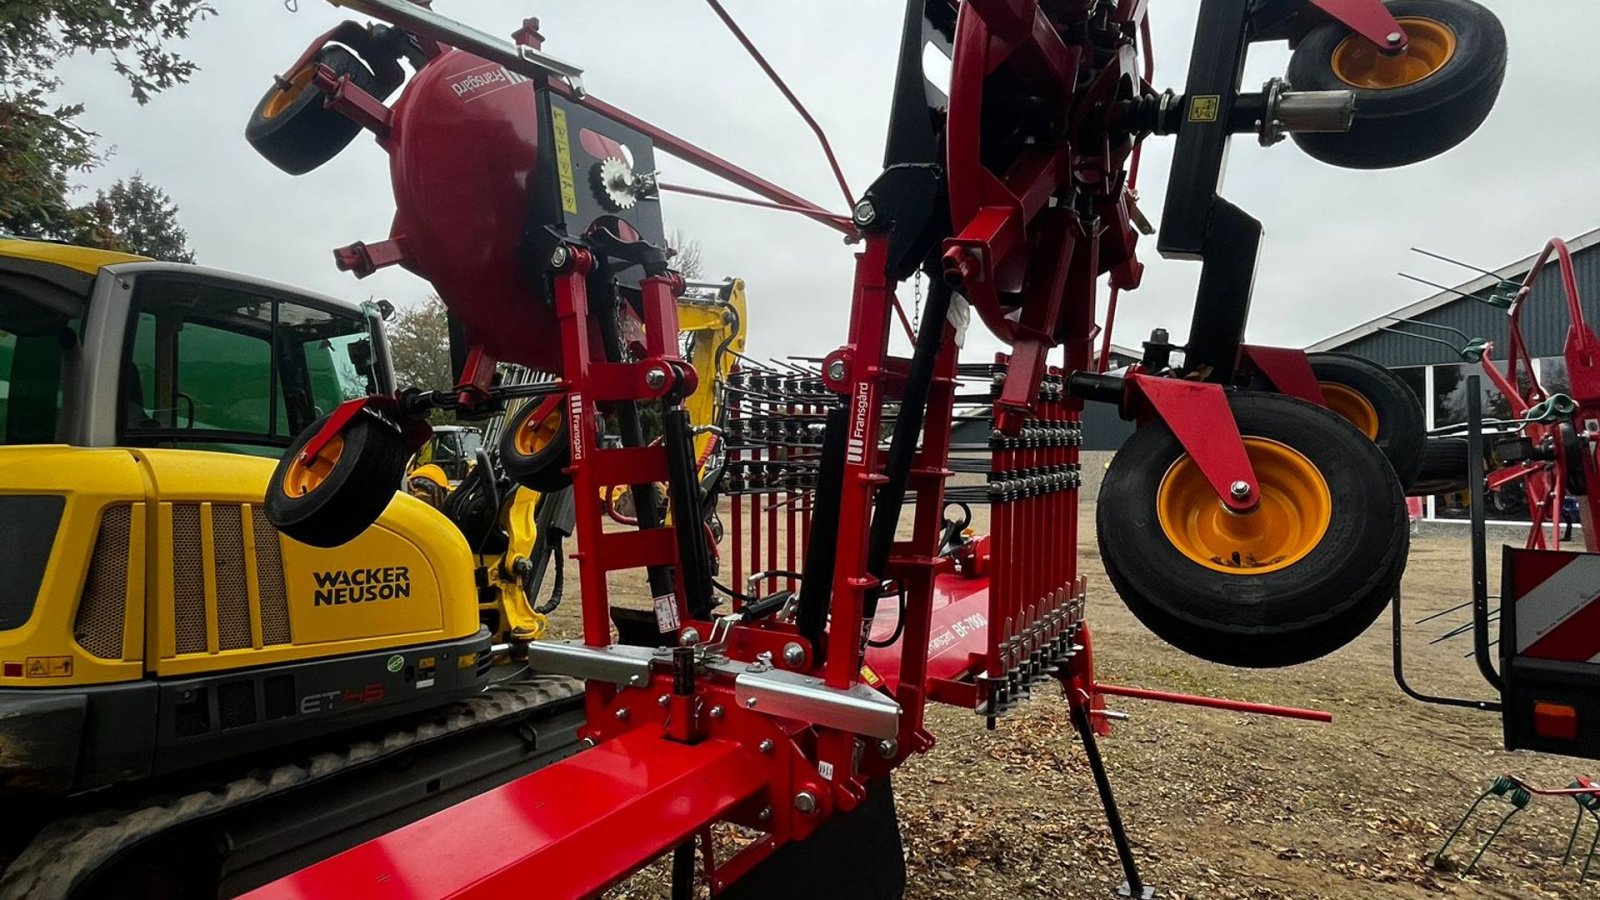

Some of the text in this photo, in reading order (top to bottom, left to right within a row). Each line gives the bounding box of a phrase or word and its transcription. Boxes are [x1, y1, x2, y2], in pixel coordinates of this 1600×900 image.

[853, 382, 869, 438] Fransgård
[312, 566, 410, 589] WACKER
[314, 582, 411, 607] NEUSON
